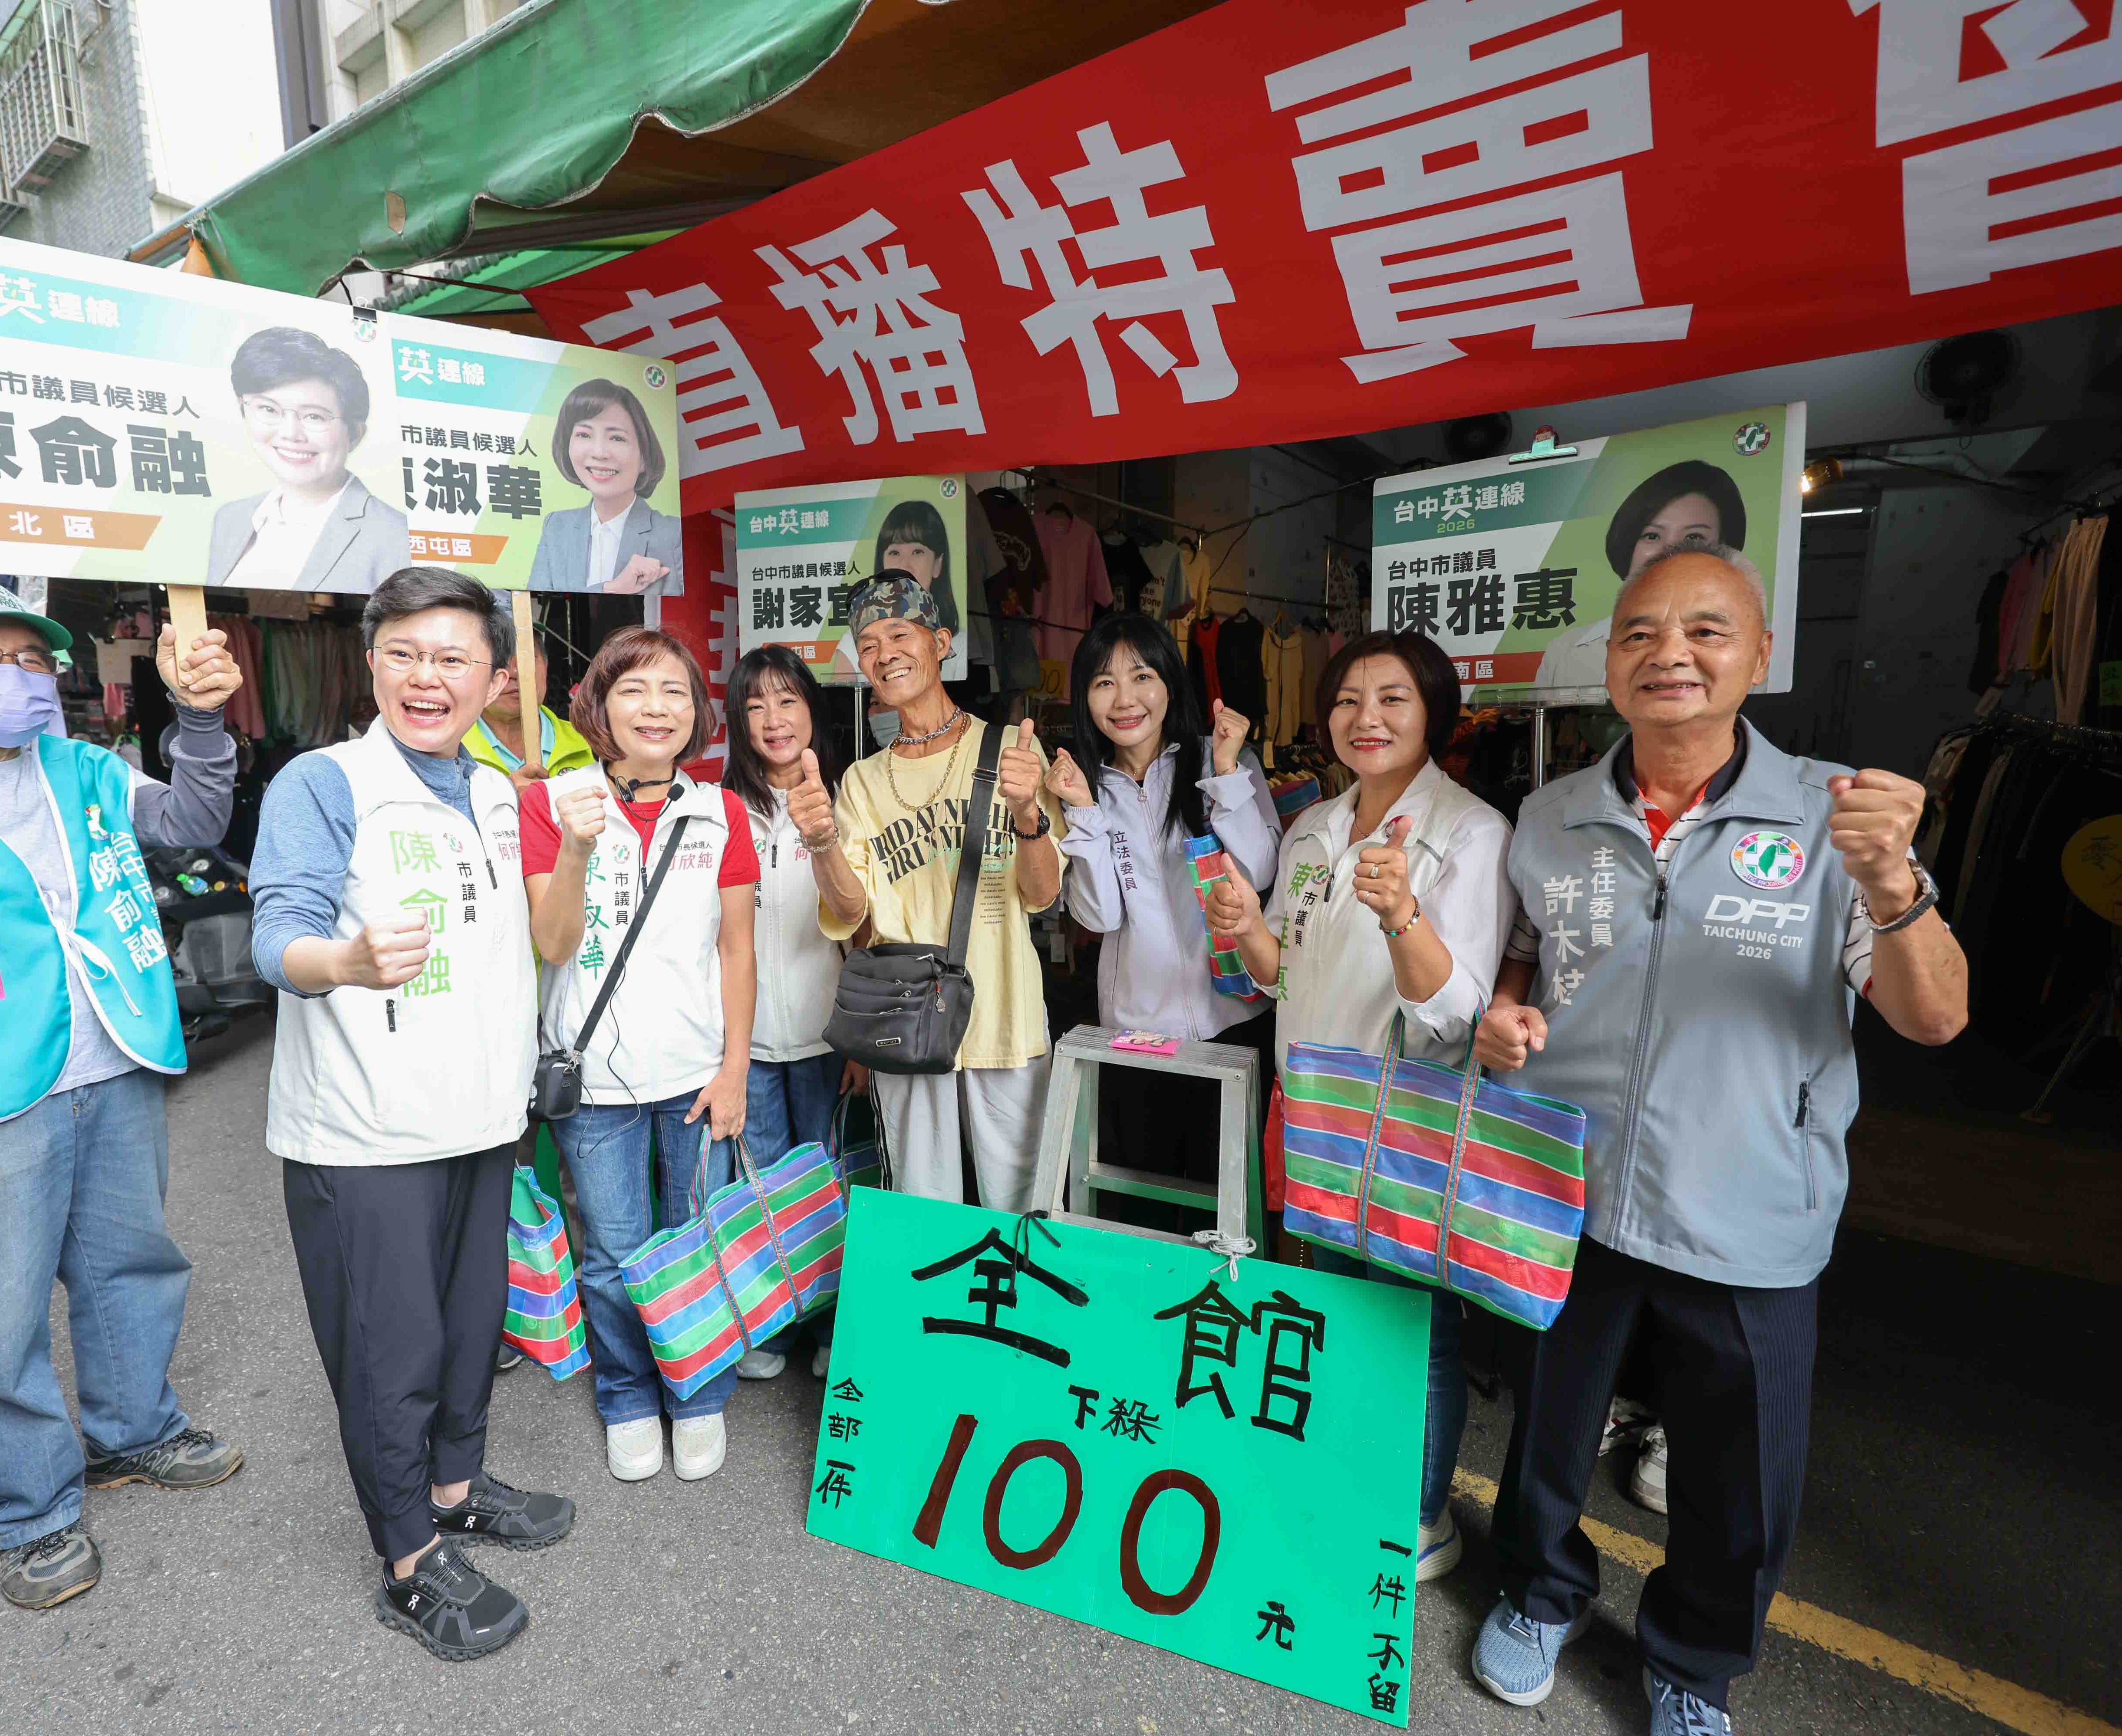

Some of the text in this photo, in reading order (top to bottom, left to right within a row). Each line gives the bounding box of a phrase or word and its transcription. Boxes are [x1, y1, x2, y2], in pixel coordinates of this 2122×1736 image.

[398, 346, 486, 386] 英連線
[0, 371, 201, 419] 市議員候選人
[401, 425, 538, 457] 市議員候選人
[750, 508, 829, 535] 台中英連線
[1394, 481, 1525, 524] 台中英連線
[9, 511, 95, 539] 北區
[409, 535, 472, 558] 西屯區
[1437, 519, 1475, 535] 2026
[752, 561, 860, 582] 台中市議員候選人
[1387, 548, 1496, 582] 台中市議員
[1388, 568, 1578, 637] 陳雅惠
[793, 644, 816, 659] 屯區
[659, 841, 712, 851] 台市長候選人
[869, 803, 939, 861] RIDAY
[1113, 830, 1137, 891] 立法委員
[89, 846, 167, 973] 陳俞融
[457, 861, 477, 923] 市議員
[614, 872, 630, 926] 市議員
[1589, 847, 1616, 947] 主任委員
[1704, 894, 1810, 928] DPP
[1295, 891, 1318, 947] 市議員
[1703, 924, 1804, 949] TAICHUNG CITY
[1736, 944, 1773, 960] 2026
[911, 1227, 1325, 1443] 全館
[912, 1414, 1220, 1616] 100
[1256, 1601, 1294, 1651] 元
[1367, 1538, 1412, 1713] 一件不留
